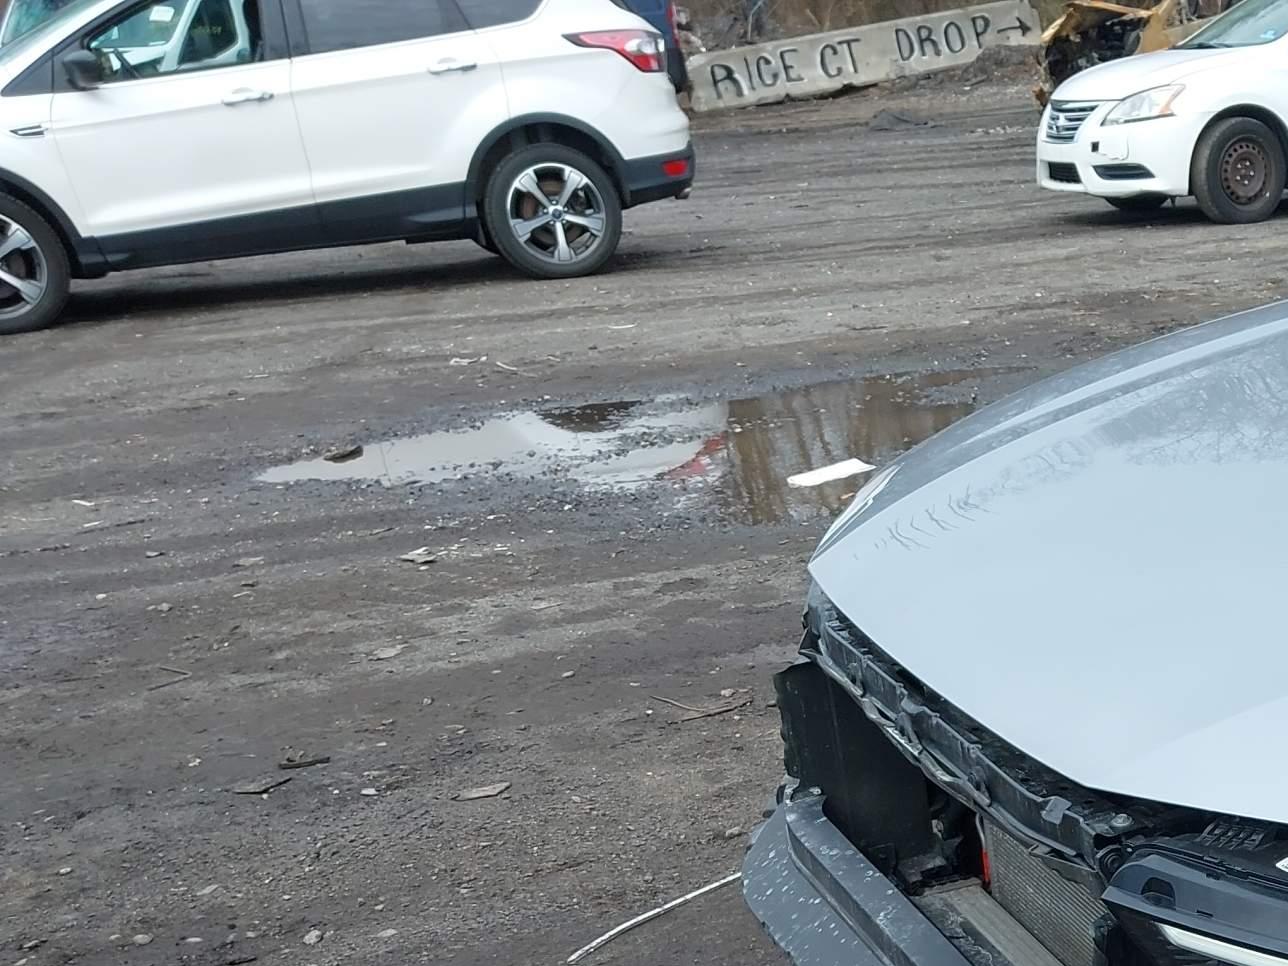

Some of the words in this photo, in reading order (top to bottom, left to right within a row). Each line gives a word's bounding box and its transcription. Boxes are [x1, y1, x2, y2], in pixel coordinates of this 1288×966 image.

[709, 48, 805, 100] RICE
[819, 38, 861, 79] CT
[894, 15, 991, 62] DROP
